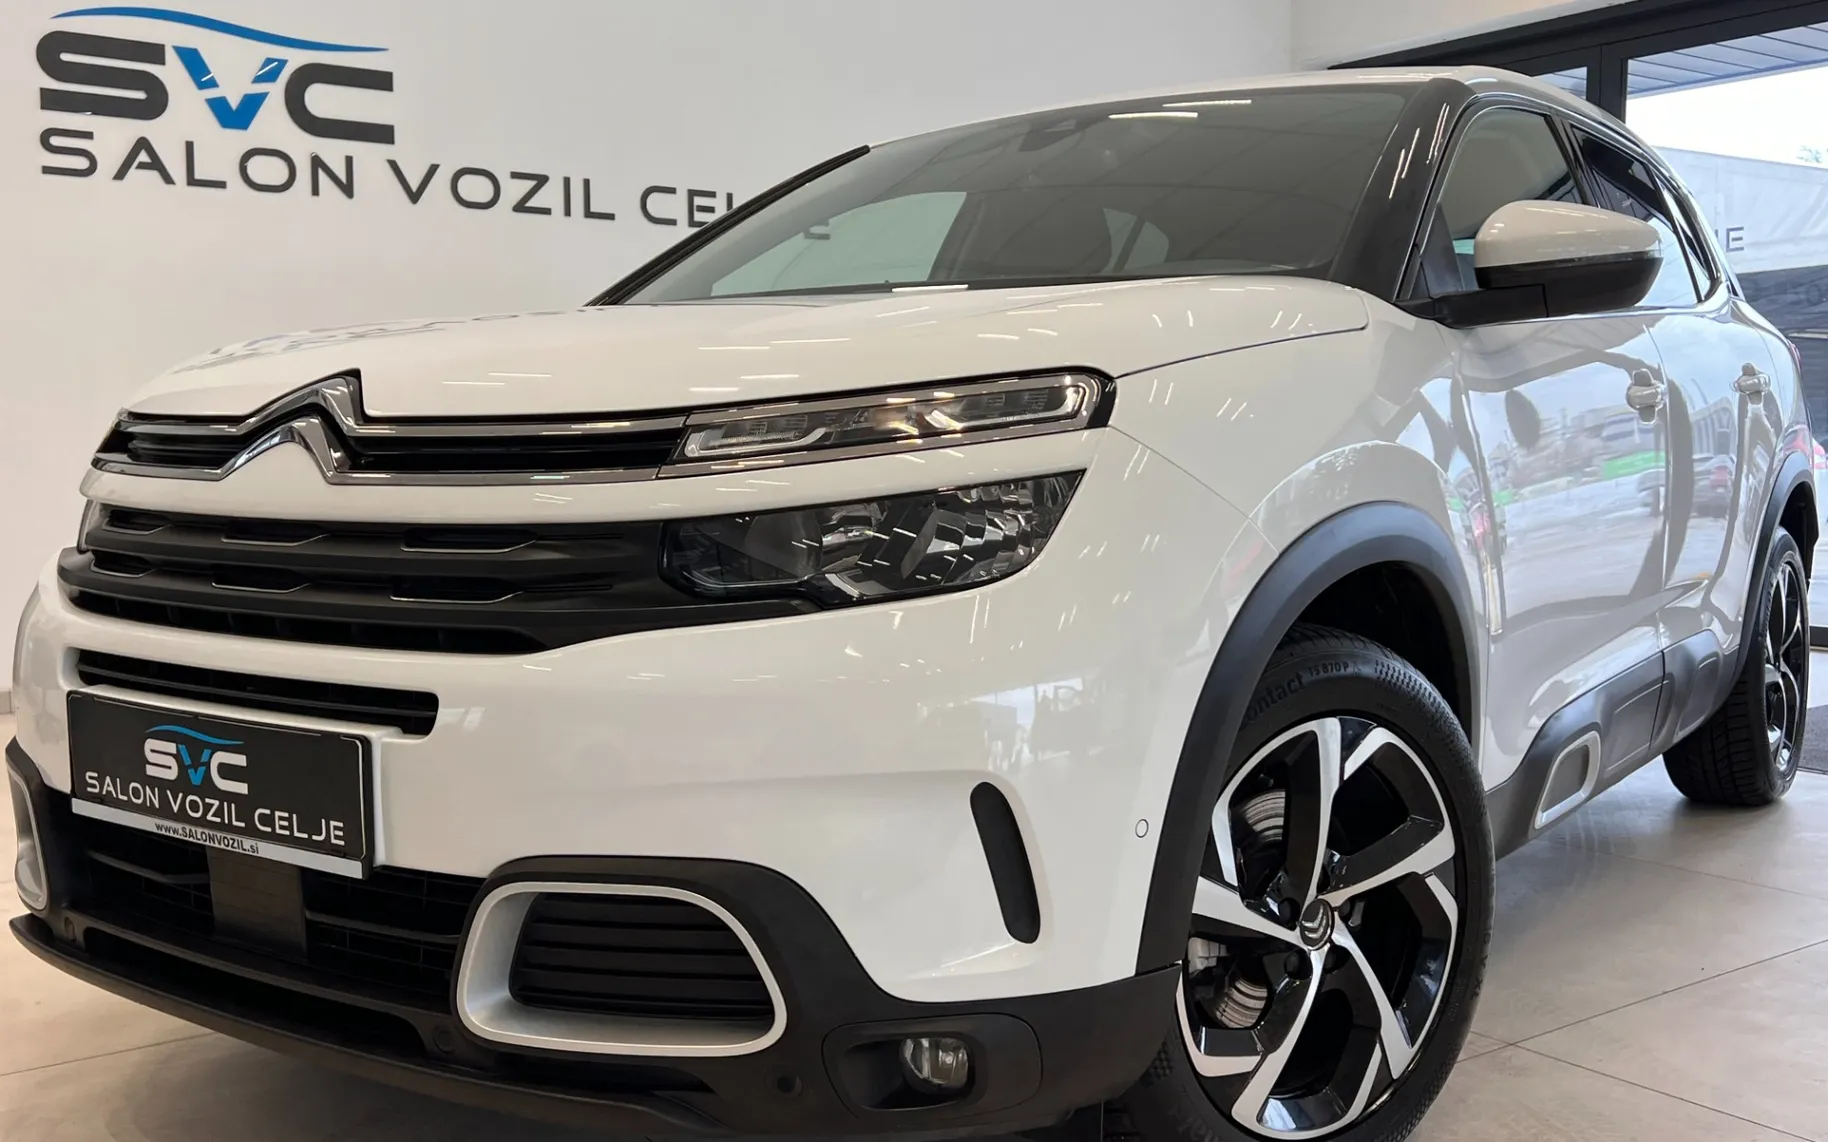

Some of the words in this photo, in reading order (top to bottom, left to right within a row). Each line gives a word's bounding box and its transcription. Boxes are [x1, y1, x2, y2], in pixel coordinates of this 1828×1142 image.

[35, 30, 395, 145] SVC
[39, 127, 354, 200] SALON
[387, 159, 616, 221] VOZIL
[144, 738, 249, 795] SVC
[85, 771, 160, 809] SALON
[166, 789, 246, 828] VOZIL
[254, 808, 345, 846] CELJE
[154, 822, 259, 855] www.SALONVOZIL.si
